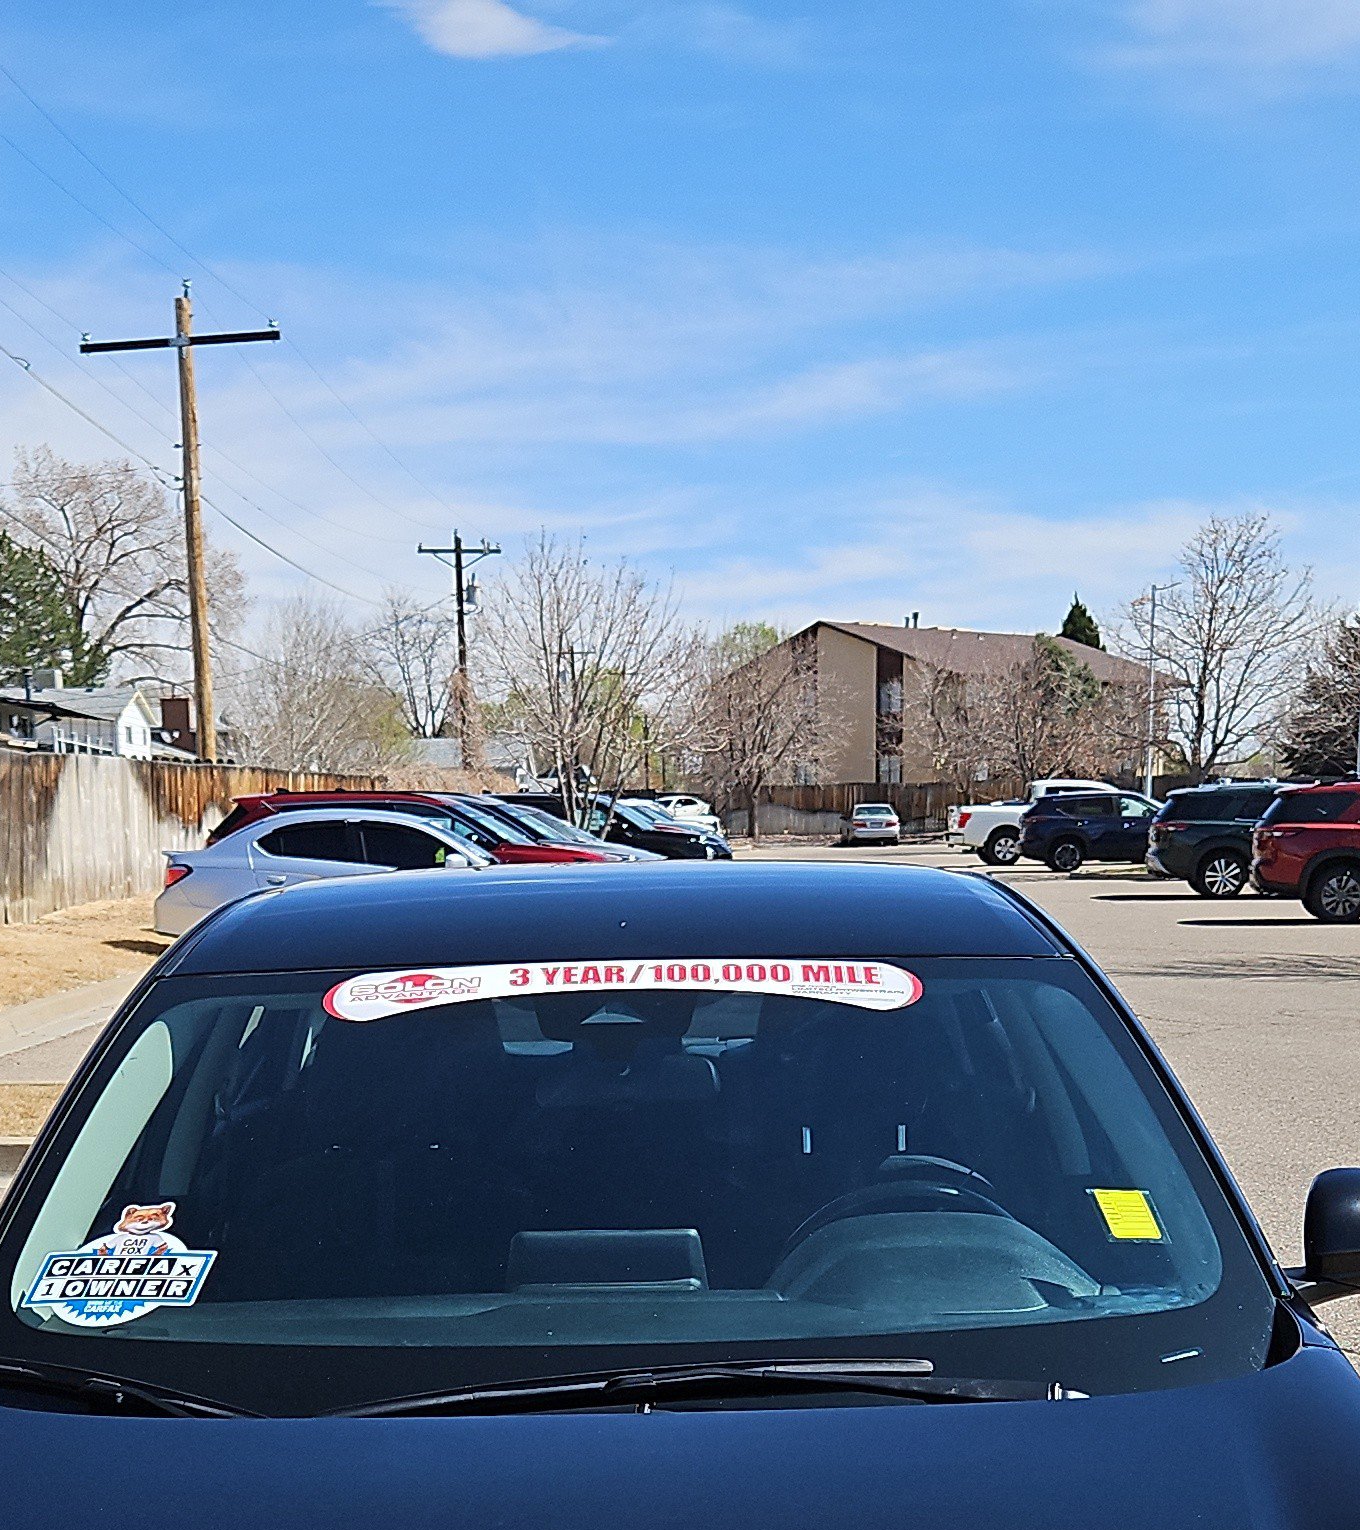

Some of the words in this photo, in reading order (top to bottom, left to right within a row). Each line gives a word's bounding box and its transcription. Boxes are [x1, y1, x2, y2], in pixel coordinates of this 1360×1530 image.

[509, 967, 530, 986] 3
[801, 964, 881, 985] MILE
[349, 976, 481, 996] SOLON
[349, 987, 479, 1002] ADVANTAGE
[120, 1247, 143, 1255] FOX
[123, 1238, 148, 1247] CAR
[51, 1259, 197, 1276] CARFAX
[40, 1282, 57, 1296] 1
[64, 1280, 188, 1297] OWNER
